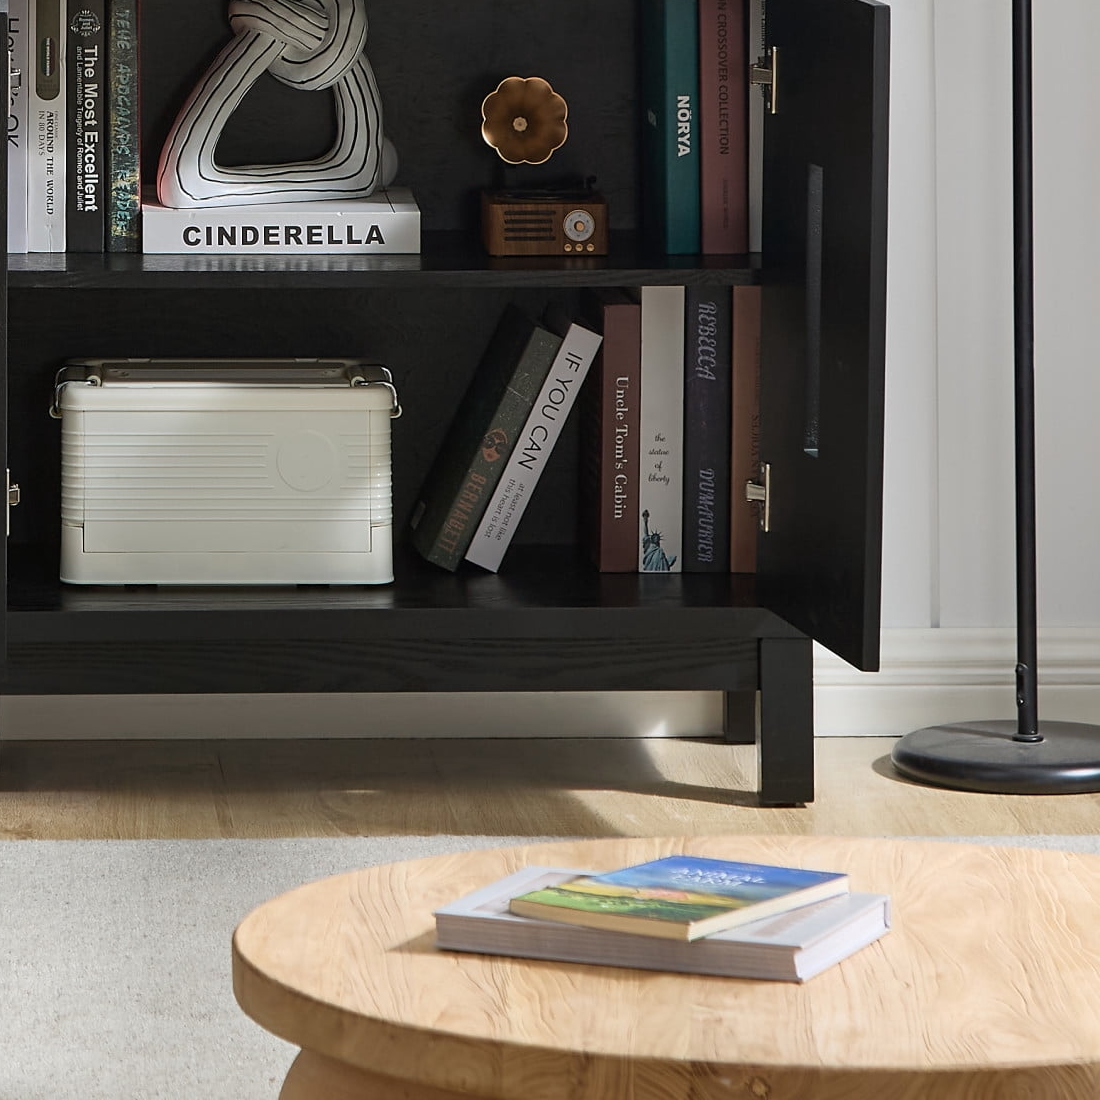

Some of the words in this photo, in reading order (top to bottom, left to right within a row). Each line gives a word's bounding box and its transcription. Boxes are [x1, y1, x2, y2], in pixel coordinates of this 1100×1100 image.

[717, 13, 729, 82] CROSSOVER
[84, 45, 98, 78] The
[38, 110, 45, 119] IN
[84, 83, 98, 126] Most
[38, 122, 45, 132] 80
[74, 107, 83, 137] Tragedy
[677, 94, 692, 157] NÖRYA
[718, 85, 730, 155] COLLECTION
[46, 110, 54, 153] AROUND
[76, 138, 83, 146] of
[46, 157, 54, 176] THE
[84, 131, 99, 212] Excellent
[46, 180, 54, 215] WORLD
[183, 224, 386, 246] CINDERELLA
[695, 301, 717, 381] REBECCA
[564, 351, 583, 372] IF
[541, 377, 573, 421] YOU
[615, 376, 629, 419] Uncle
[517, 424, 548, 470] CAN
[615, 423, 628, 470] Tom's
[654, 433, 666, 442] the
[654, 460, 663, 472] of
[505, 478, 516, 493] this
[518, 483, 525, 492] at
[648, 473, 670, 486] liberty
[496, 494, 510, 515] heart
[509, 492, 524, 511] least
[614, 474, 628, 519] Cabin
[491, 515, 499, 523] is
[502, 512, 512, 526] not
[696, 468, 715, 562] DUMAURIER
[484, 523, 497, 538] lost
[495, 527, 507, 541] like
